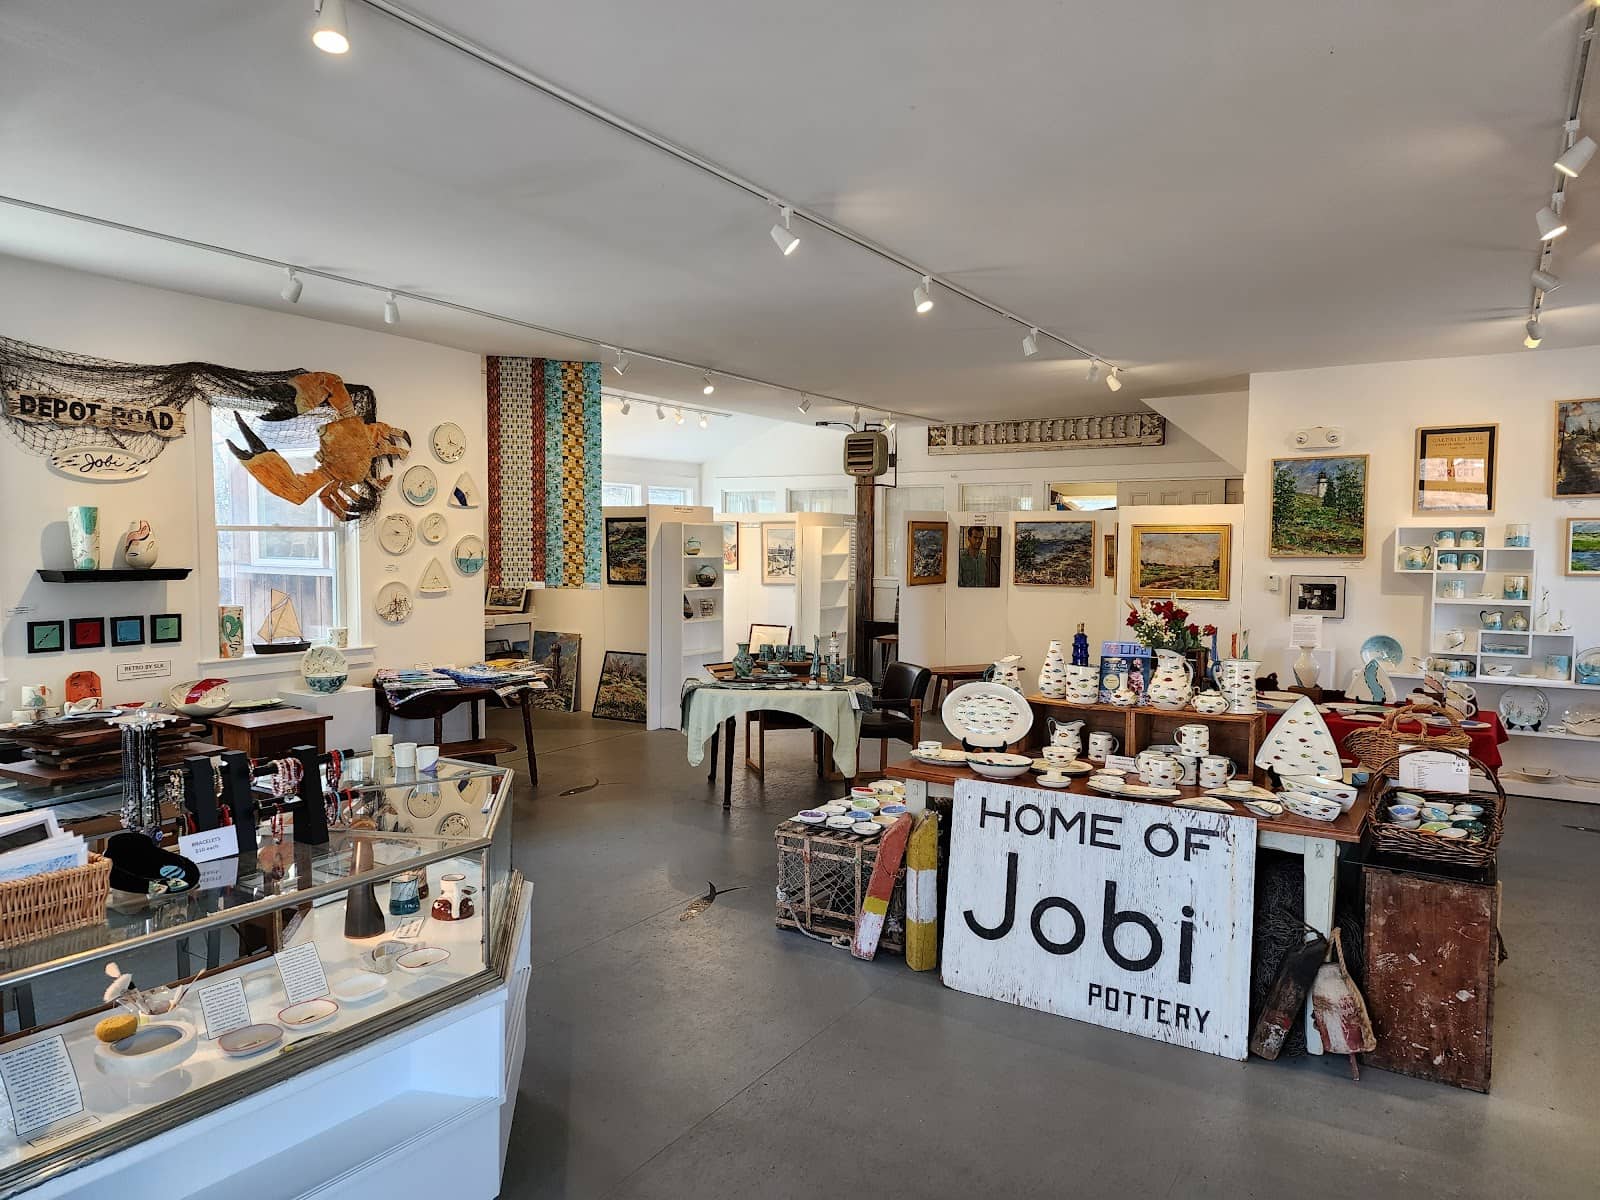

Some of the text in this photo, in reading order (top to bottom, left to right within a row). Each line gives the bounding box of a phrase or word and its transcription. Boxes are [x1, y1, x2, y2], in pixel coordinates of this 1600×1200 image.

[20, 394, 174, 430] DEPOT ROAD
[79, 453, 125, 473] Jobi
[980, 797, 1220, 861] HOME OF
[963, 852, 1194, 984] Jobi
[1088, 983, 1210, 1033] POTTERY
